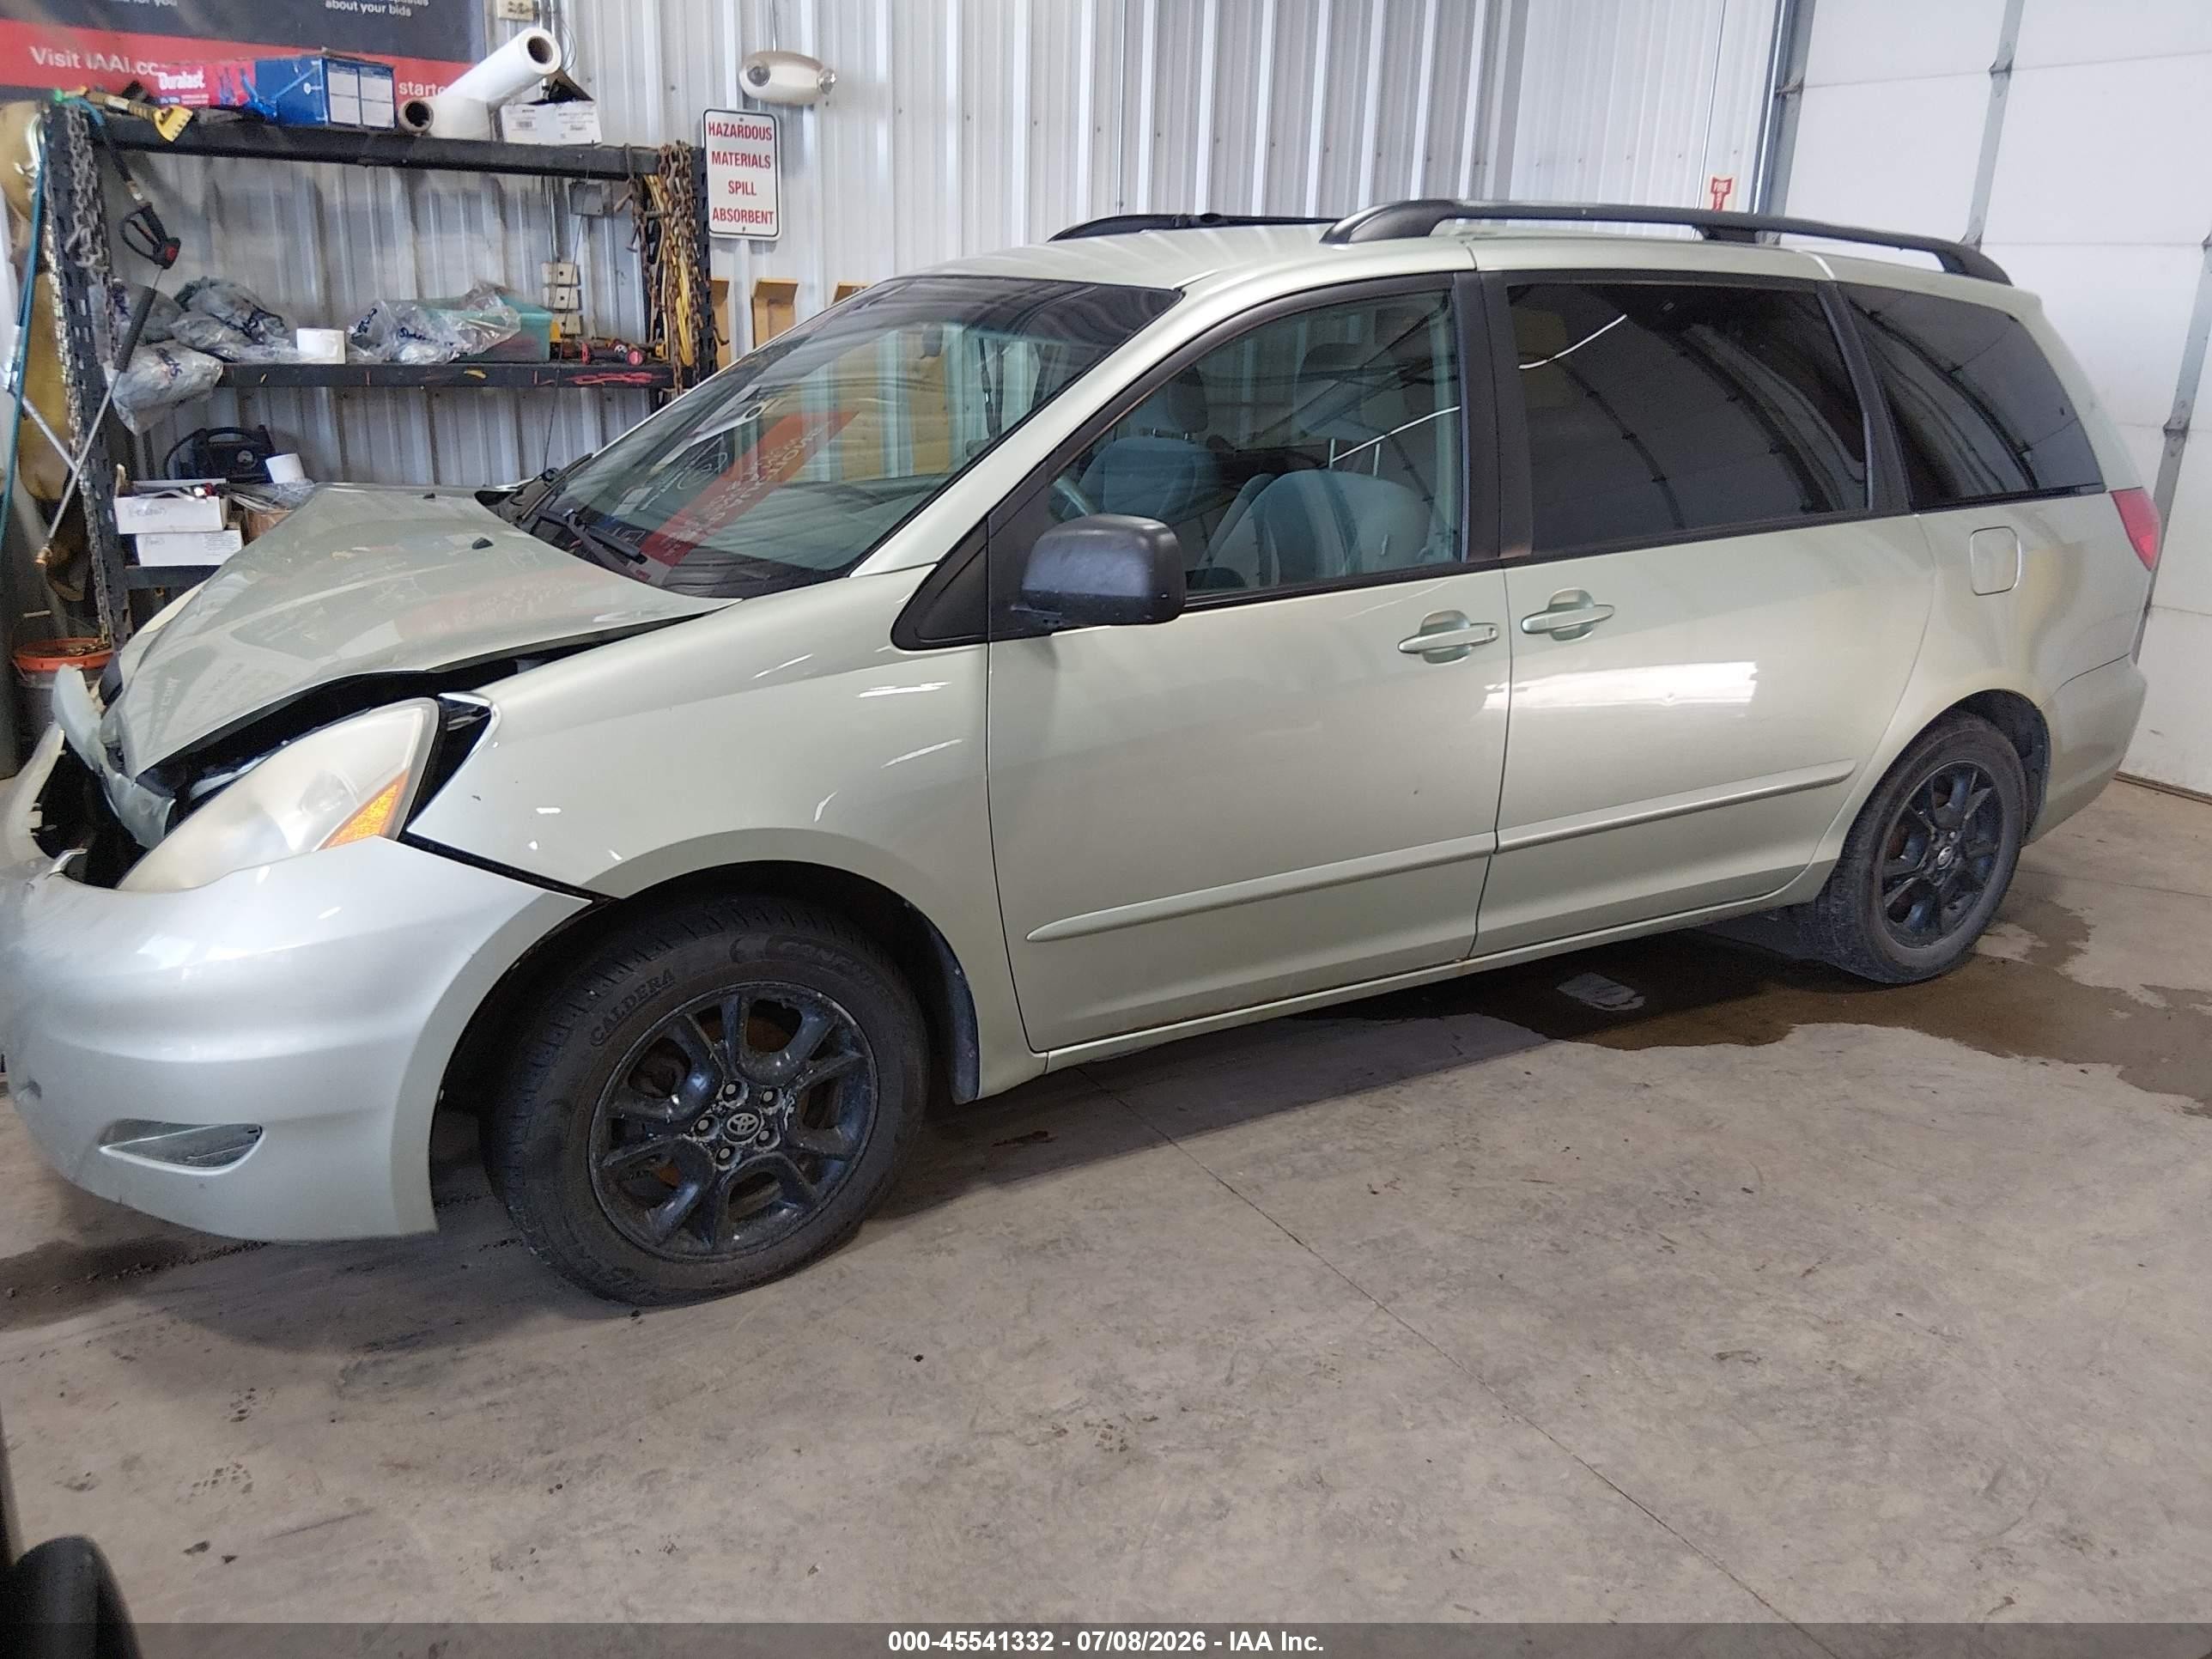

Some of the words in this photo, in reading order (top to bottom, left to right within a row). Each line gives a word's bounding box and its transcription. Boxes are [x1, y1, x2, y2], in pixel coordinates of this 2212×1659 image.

[325, 0, 358, 11] about
[361, 3, 386, 14] your
[388, 3, 412, 17] bids
[29, 46, 82, 69] Visit
[708, 121, 773, 141] HAZARDOUS
[711, 150, 771, 169] MATERIALS
[728, 180, 757, 196] SPILL
[712, 207, 774, 224] ABSORBENT
[589, 968, 675, 1047] CALDERA
